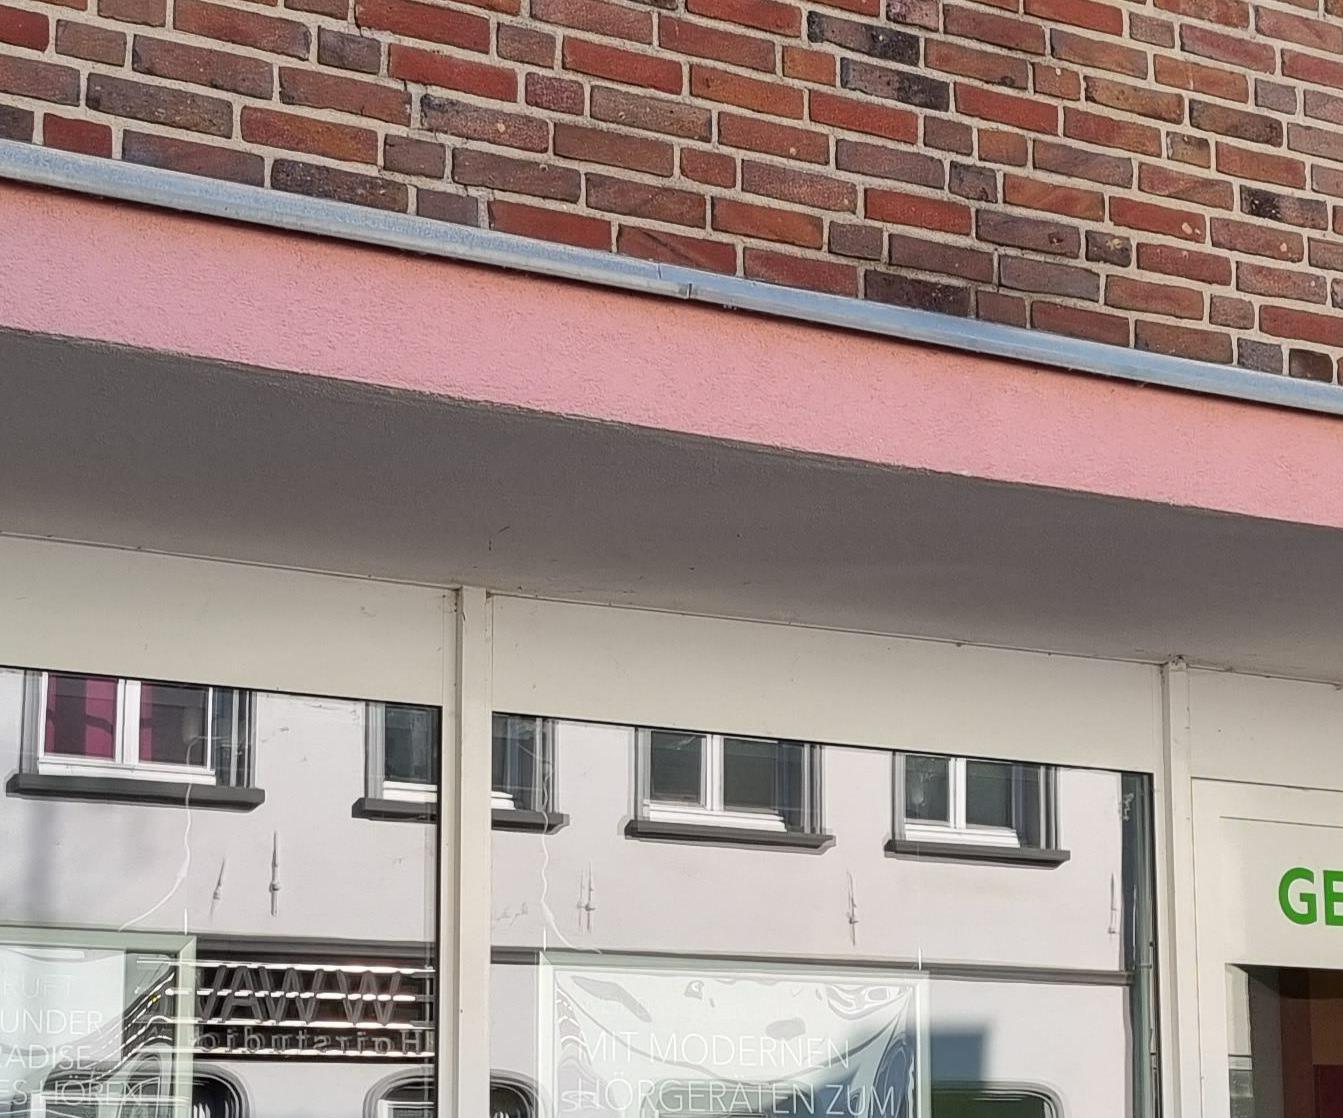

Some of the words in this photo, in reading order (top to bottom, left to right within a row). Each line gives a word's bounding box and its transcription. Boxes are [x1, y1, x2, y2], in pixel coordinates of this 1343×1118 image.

[579, 1031, 638, 1063] MIT
[649, 1033, 849, 1069] MODERNEN
[577, 1072, 814, 1115] HÖRGERÄTEN
[826, 1084, 895, 1117] ZUM
